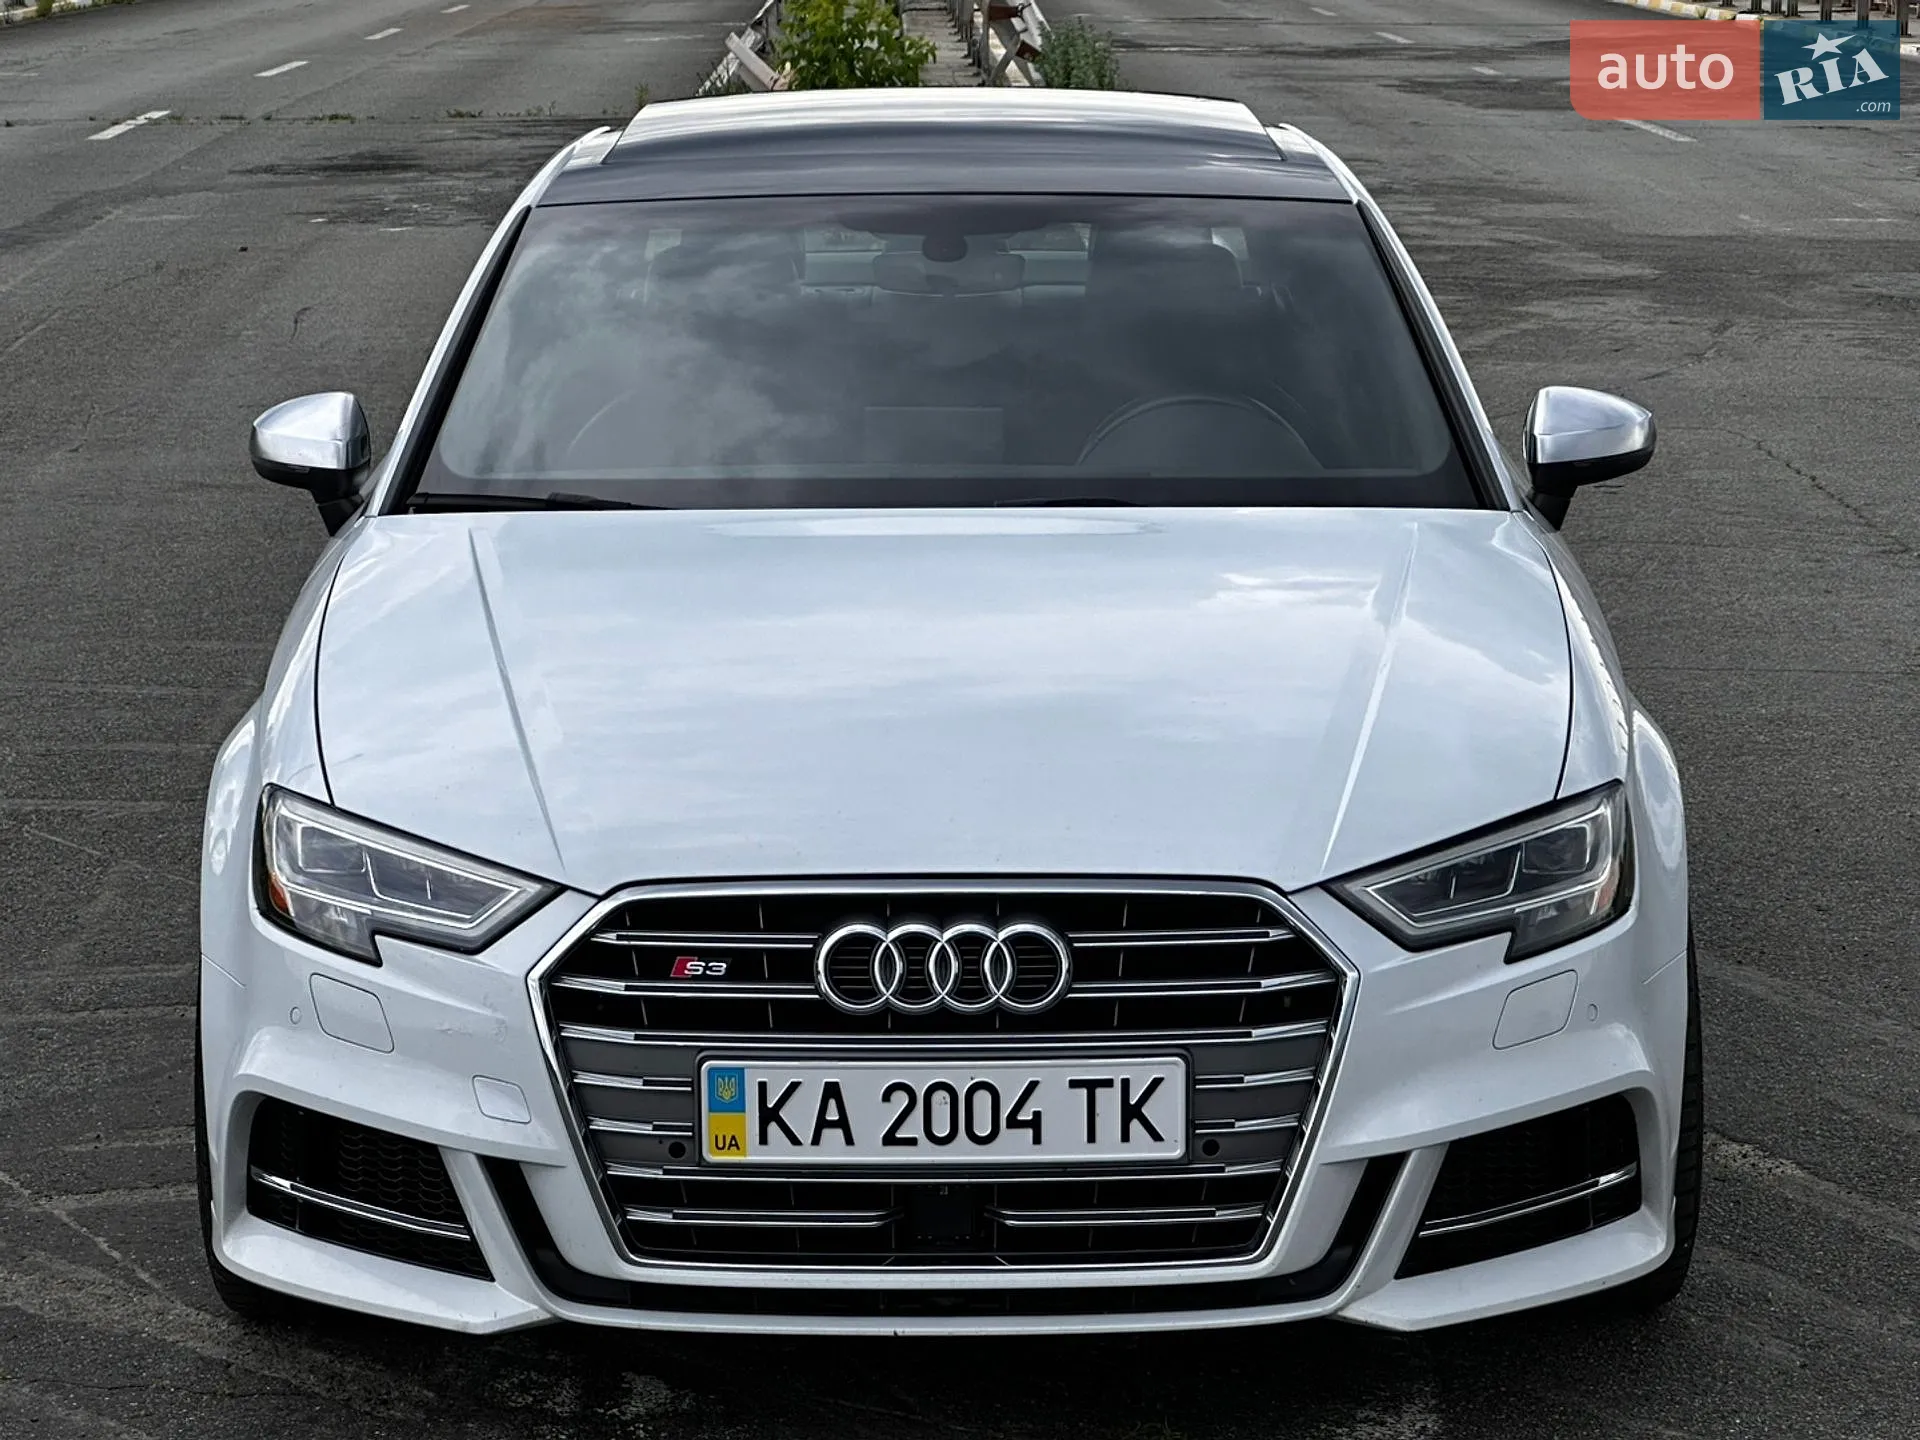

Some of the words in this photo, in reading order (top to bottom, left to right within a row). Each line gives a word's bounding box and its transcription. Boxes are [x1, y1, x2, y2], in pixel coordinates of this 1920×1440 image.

[683, 961, 727, 976] S3
[757, 1080, 855, 1147] KA
[880, 1080, 1042, 1147] 2004
[1068, 1076, 1165, 1144] TK
[714, 1134, 741, 1152] UA
